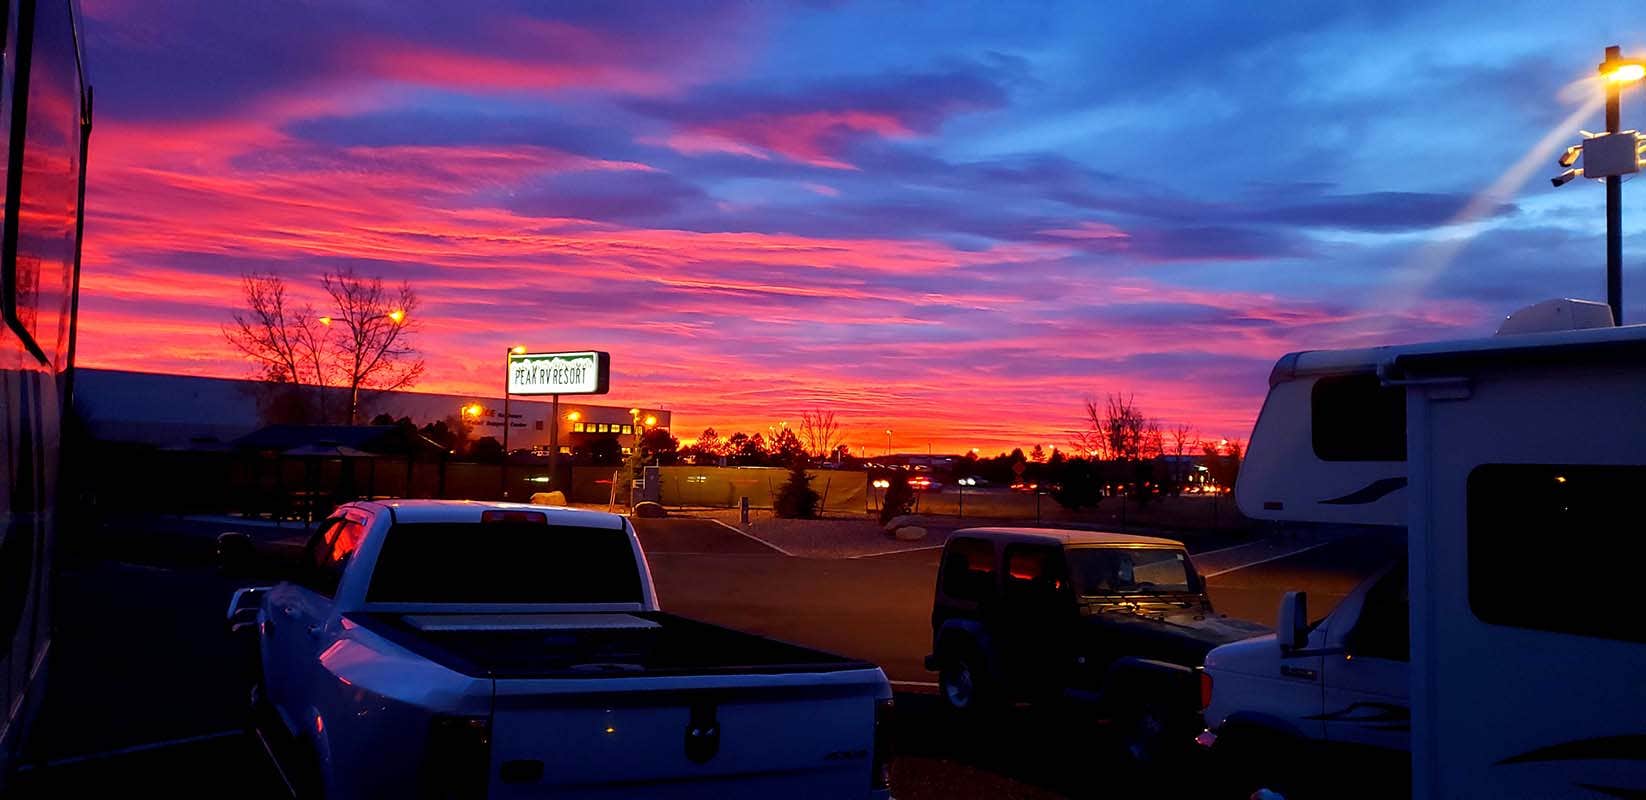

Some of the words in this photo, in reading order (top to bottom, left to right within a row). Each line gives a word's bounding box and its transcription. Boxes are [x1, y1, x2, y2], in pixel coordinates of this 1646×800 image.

[515, 366, 537, 385] PEAK
[539, 368, 551, 385] RV
[553, 367, 586, 385] RESORT
